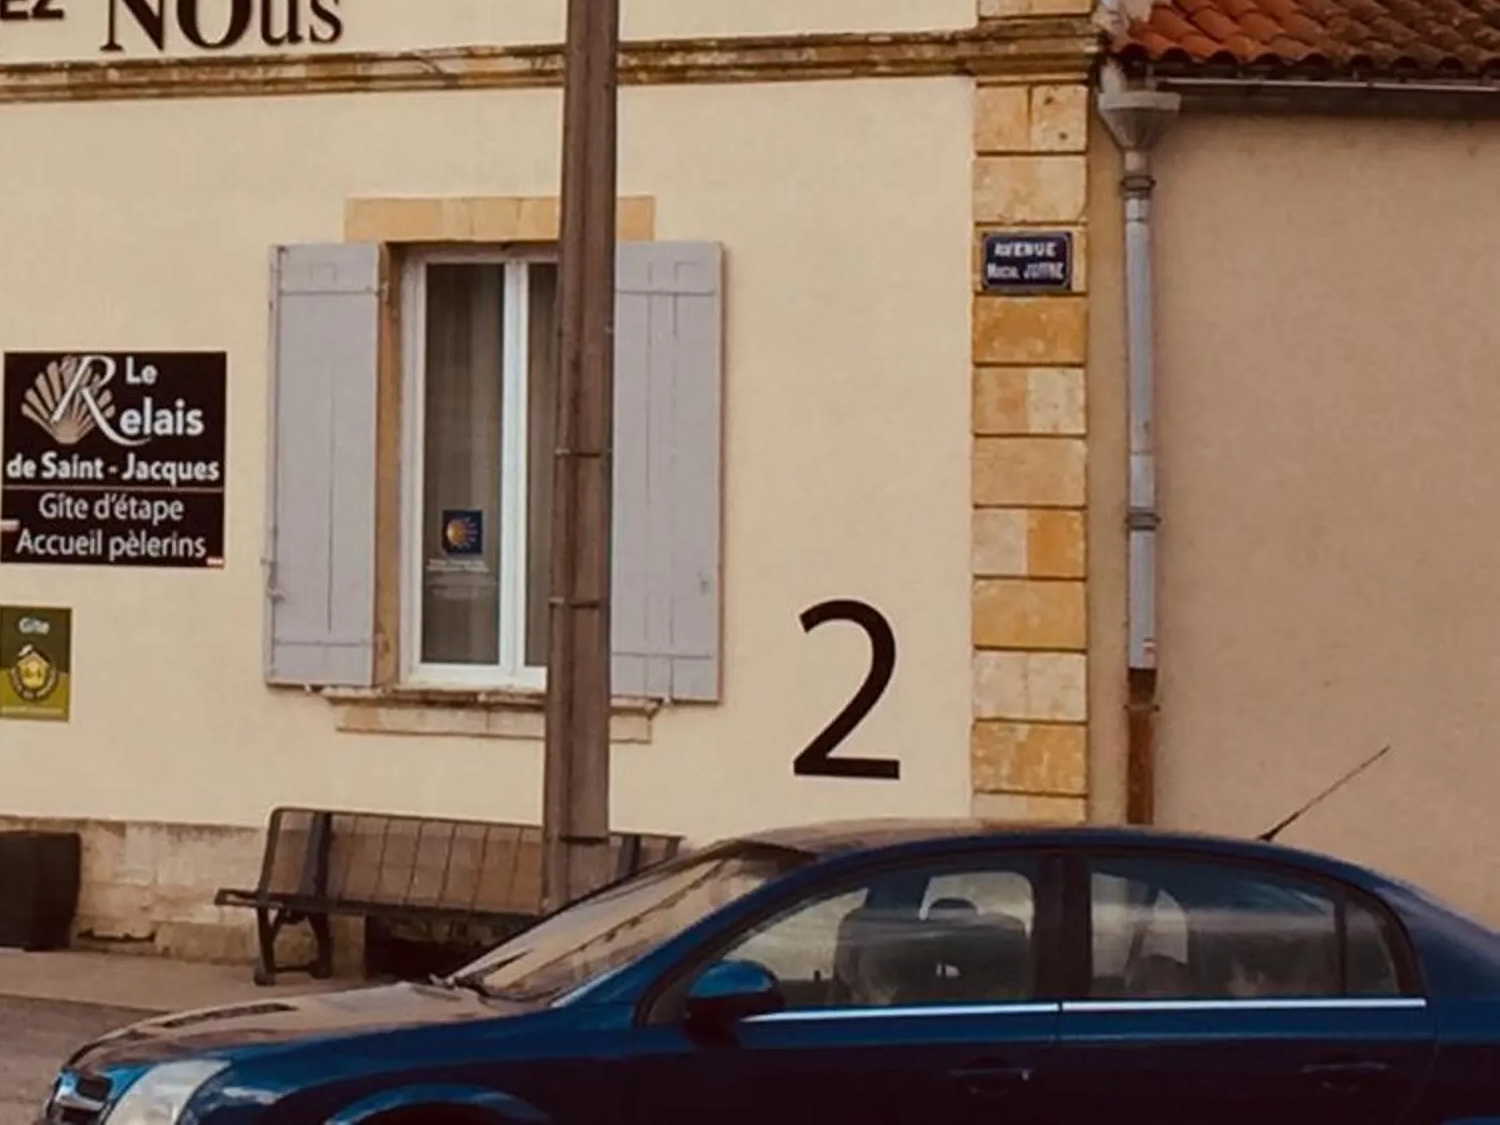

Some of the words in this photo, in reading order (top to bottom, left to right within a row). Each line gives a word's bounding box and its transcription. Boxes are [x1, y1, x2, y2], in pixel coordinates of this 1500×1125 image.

[126, 356, 158, 385] Le
[6, 453, 37, 479] de
[38, 492, 89, 520] Gîte
[93, 492, 185, 526] d'étape
[15, 528, 103, 556] Accueil
[108, 529, 207, 562] pèlerins
[793, 599, 901, 780] 2
